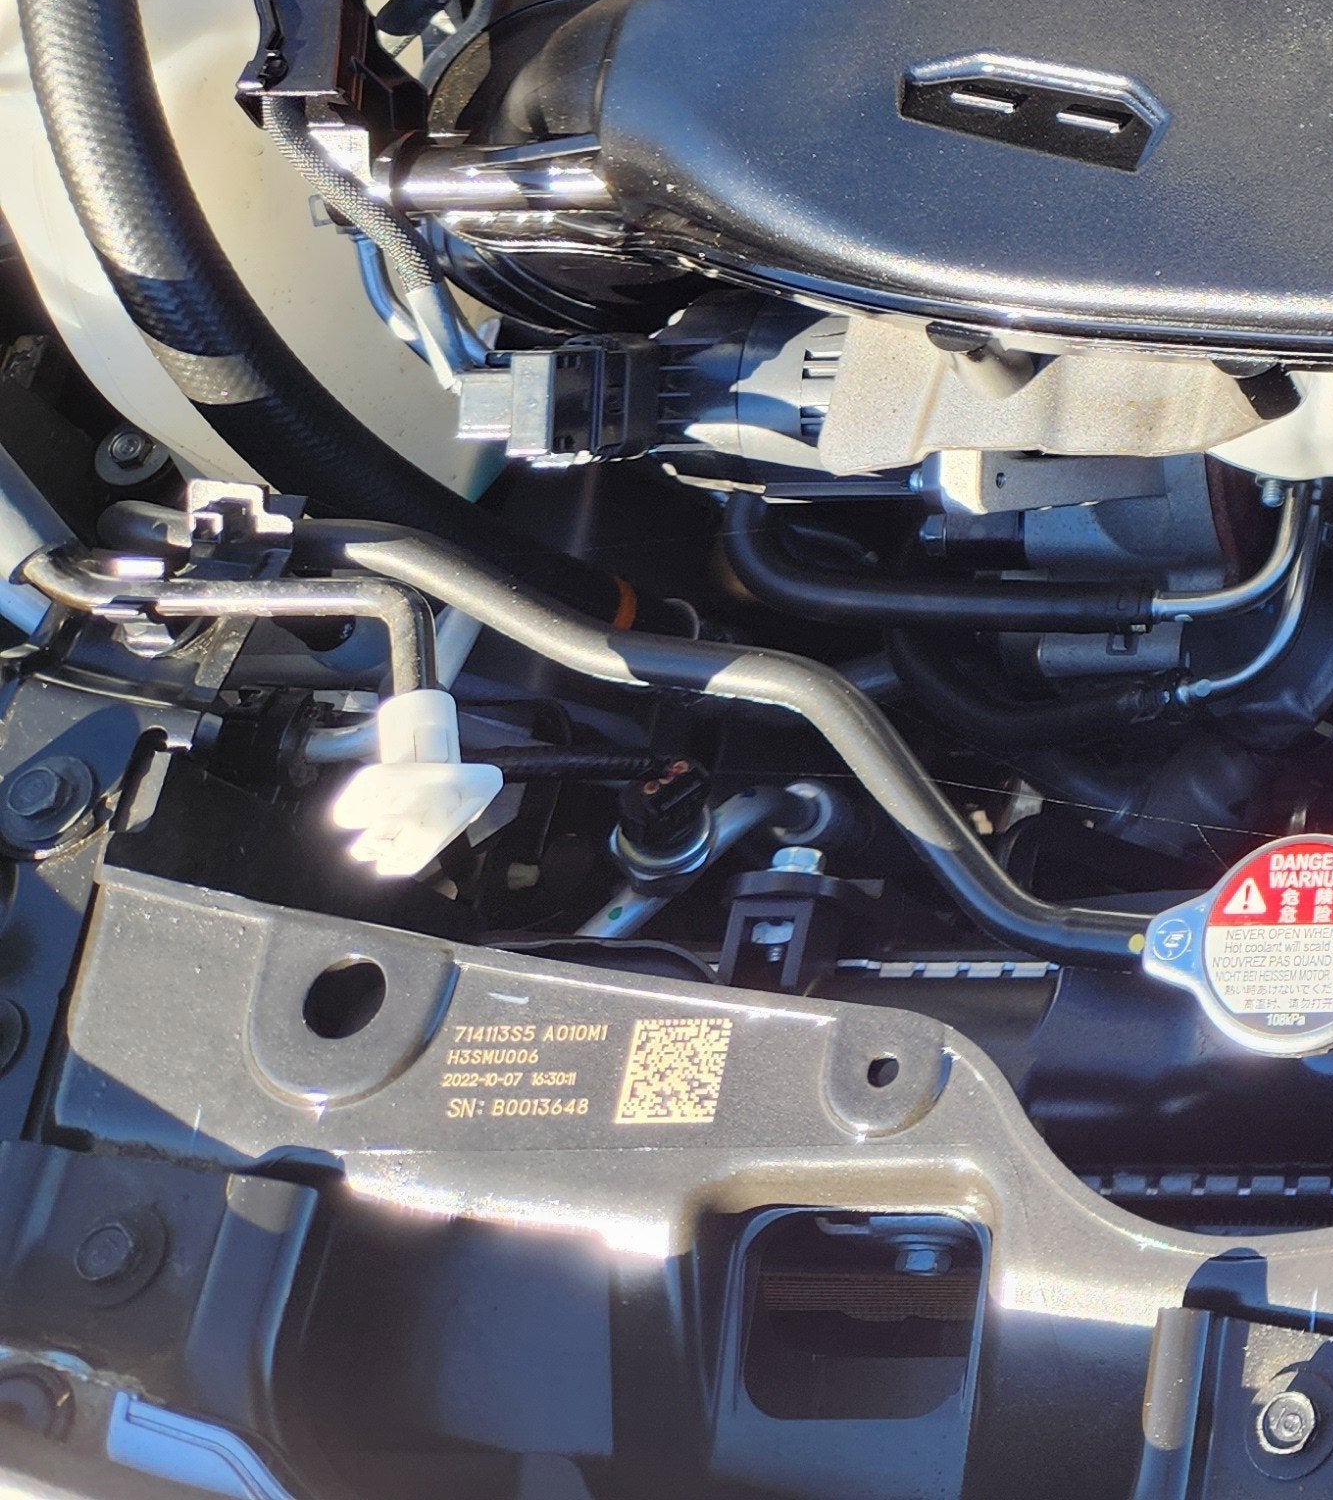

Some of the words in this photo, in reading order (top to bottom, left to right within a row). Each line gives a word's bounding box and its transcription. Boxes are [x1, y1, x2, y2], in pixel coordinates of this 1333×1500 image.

[1226, 929, 1265, 940] NEVER
[1269, 928, 1301, 940] OPEN
[1224, 942, 1243, 954] Hot
[1245, 941, 1283, 953] coolant
[1285, 941, 1301, 952] will
[1304, 941, 1331, 952] scald
[1212, 956, 1267, 968] N'OUVREZ
[1269, 955, 1291, 967] PAS
[1293, 954, 1333, 968] QUAND
[1215, 970, 1242, 982] NICHT
[1259, 970, 1298, 982] HEISSEM
[1299, 969, 1331, 981] MOTOR
[1266, 1013, 1306, 1026] 108kPa
[454, 1025, 537, 1043] 714113S5
[543, 1024, 609, 1042] A010M1
[446, 1048, 539, 1065] H3SMU006
[442, 1072, 524, 1087] 2022-10-07
[531, 1071, 577, 1087] 16:30:11
[447, 1097, 485, 1118] SN:
[491, 1098, 589, 1117] B0013648
